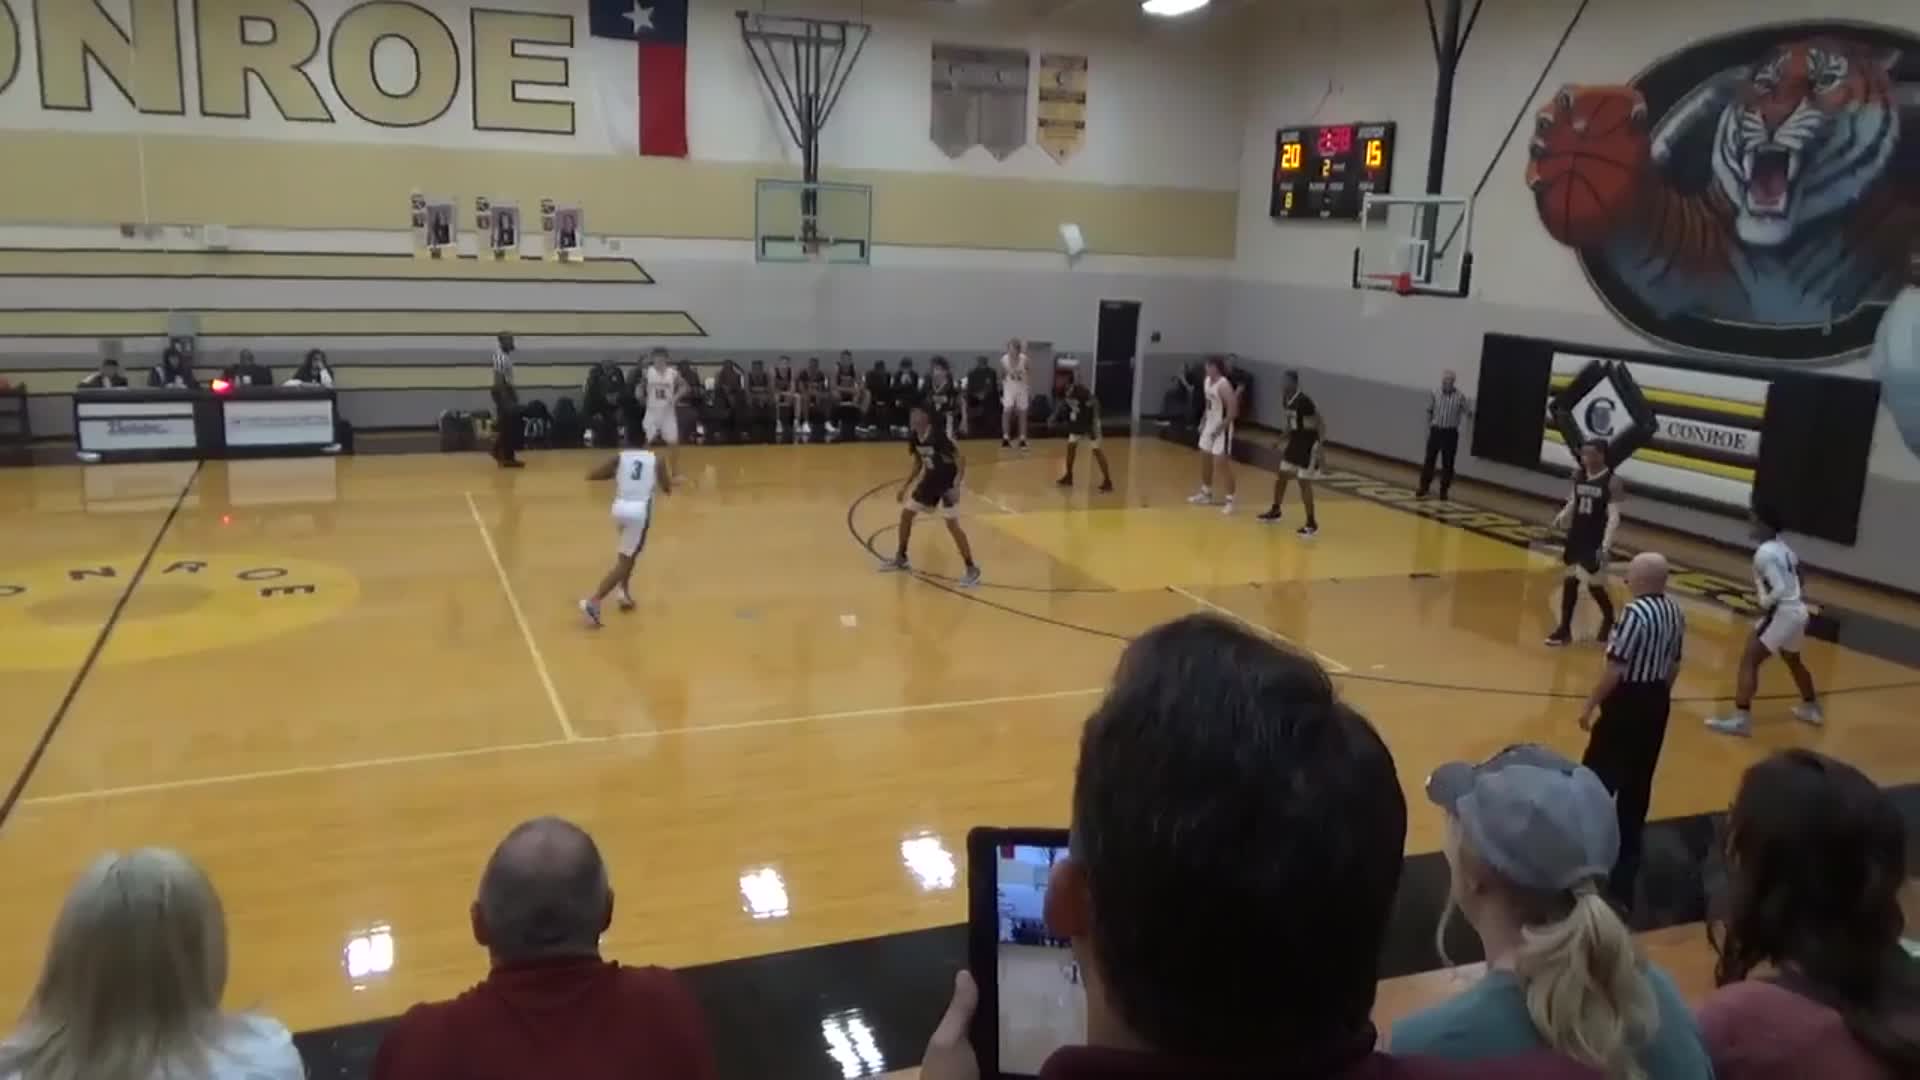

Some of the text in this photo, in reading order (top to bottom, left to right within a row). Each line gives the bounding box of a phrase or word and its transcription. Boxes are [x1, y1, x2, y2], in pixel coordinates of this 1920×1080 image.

[0, 0, 576, 135] NROE
[1280, 143, 1301, 169] 20
[1365, 140, 1382, 167] 15
[1322, 159, 1331, 177] 2
[1584, 396, 1616, 437] C
[1667, 421, 1748, 450] CONROE
[631, 460, 643, 480] 3
